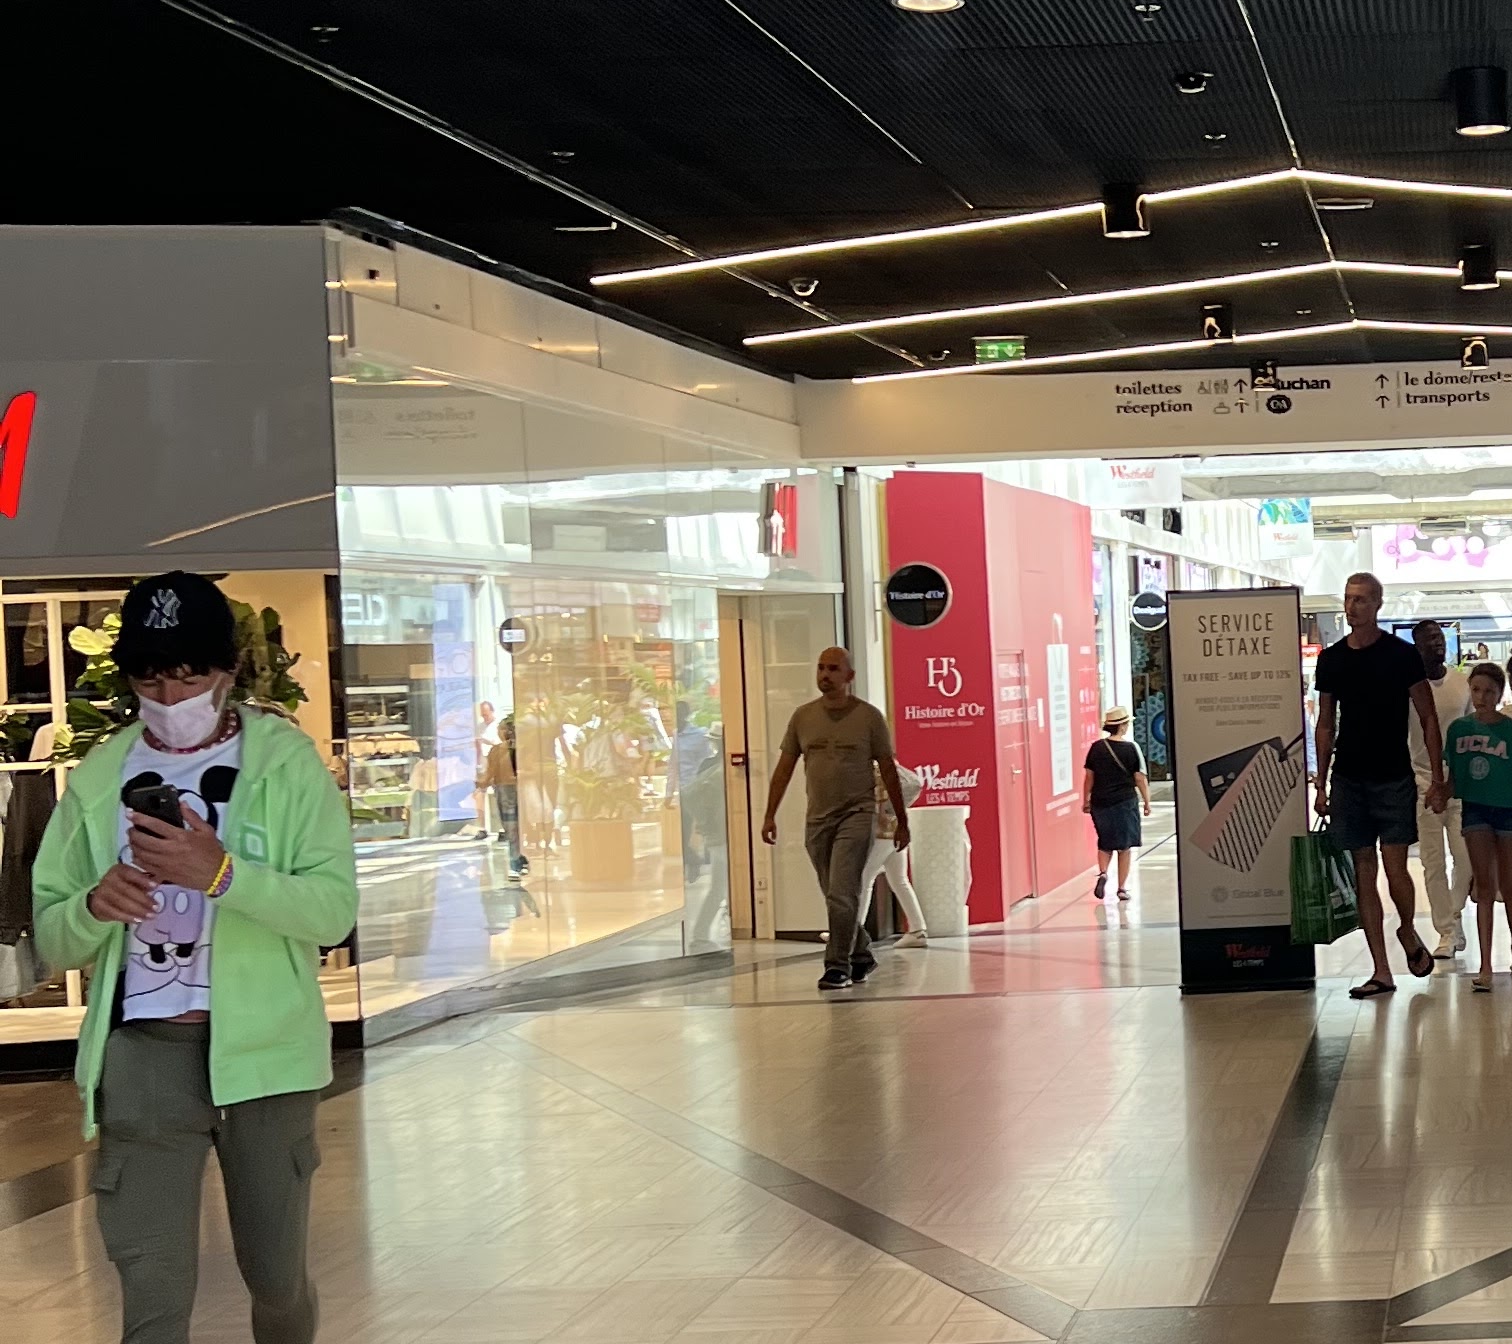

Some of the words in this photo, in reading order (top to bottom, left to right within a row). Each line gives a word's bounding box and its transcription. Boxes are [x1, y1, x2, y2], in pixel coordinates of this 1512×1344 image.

[1275, 377, 1331, 392] uchan
[1405, 371, 1419, 386] le
[1115, 381, 1182, 395] toilettes
[1406, 389, 1490, 406] transports
[1115, 399, 1193, 416] réception
[1198, 613, 1274, 634] SERVICE
[1202, 633, 1272, 657] DÉTAXE
[1183, 673, 1198, 682] TAX
[1199, 672, 1219, 682] FREE
[1228, 671, 1248, 681] SAVE
[1250, 671, 1261, 680] UP
[1264, 670, 1274, 680] TO
[904, 704, 956, 720] Histoire
[957, 702, 986, 717] d'Or
[1455, 734, 1510, 760] UCLA
[914, 763, 981, 791] Westfield
[926, 793, 940, 805] LES
[946, 791, 970, 803] TEMPS
